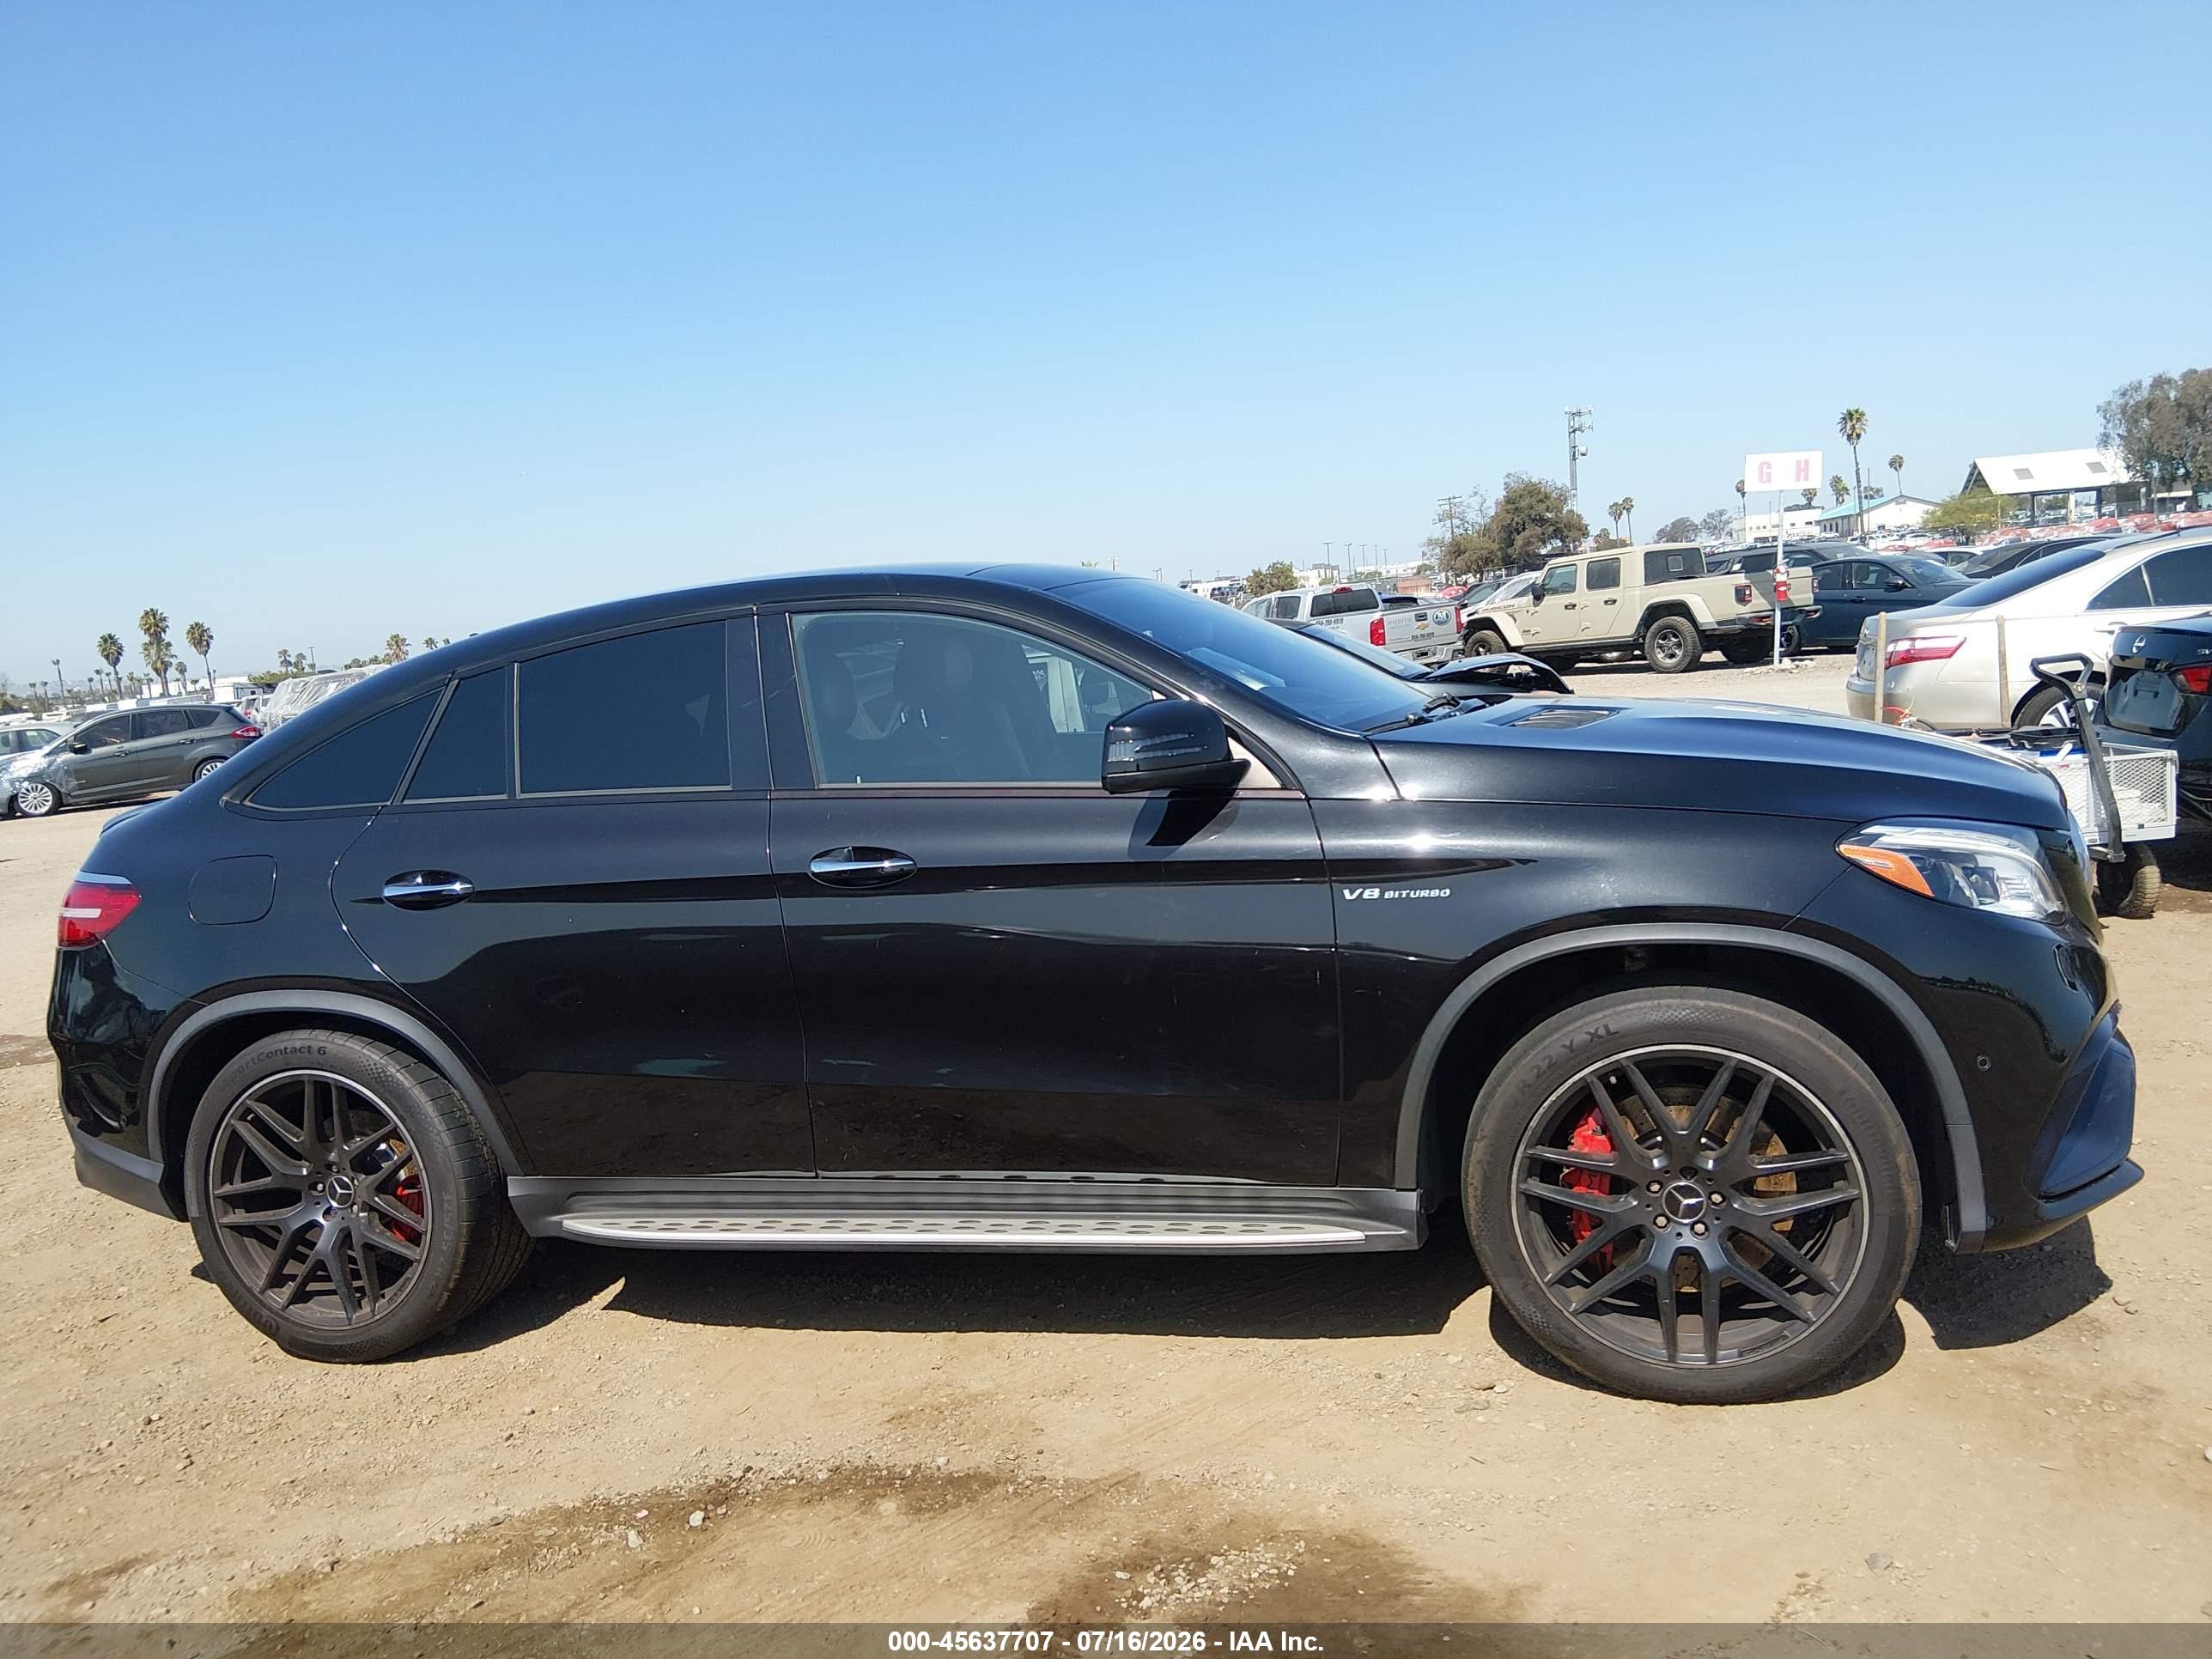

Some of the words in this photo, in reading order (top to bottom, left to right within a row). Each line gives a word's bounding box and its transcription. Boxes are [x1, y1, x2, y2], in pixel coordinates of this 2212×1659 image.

[1758, 460, 1772, 483] G
[1795, 459, 1809, 482] H
[1342, 887, 1381, 901] V8
[1383, 888, 1451, 899] BITURBO
[1559, 1037, 1576, 1054] Y
[1584, 1023, 1620, 1043] XL
[317, 1045, 328, 1056] 6
